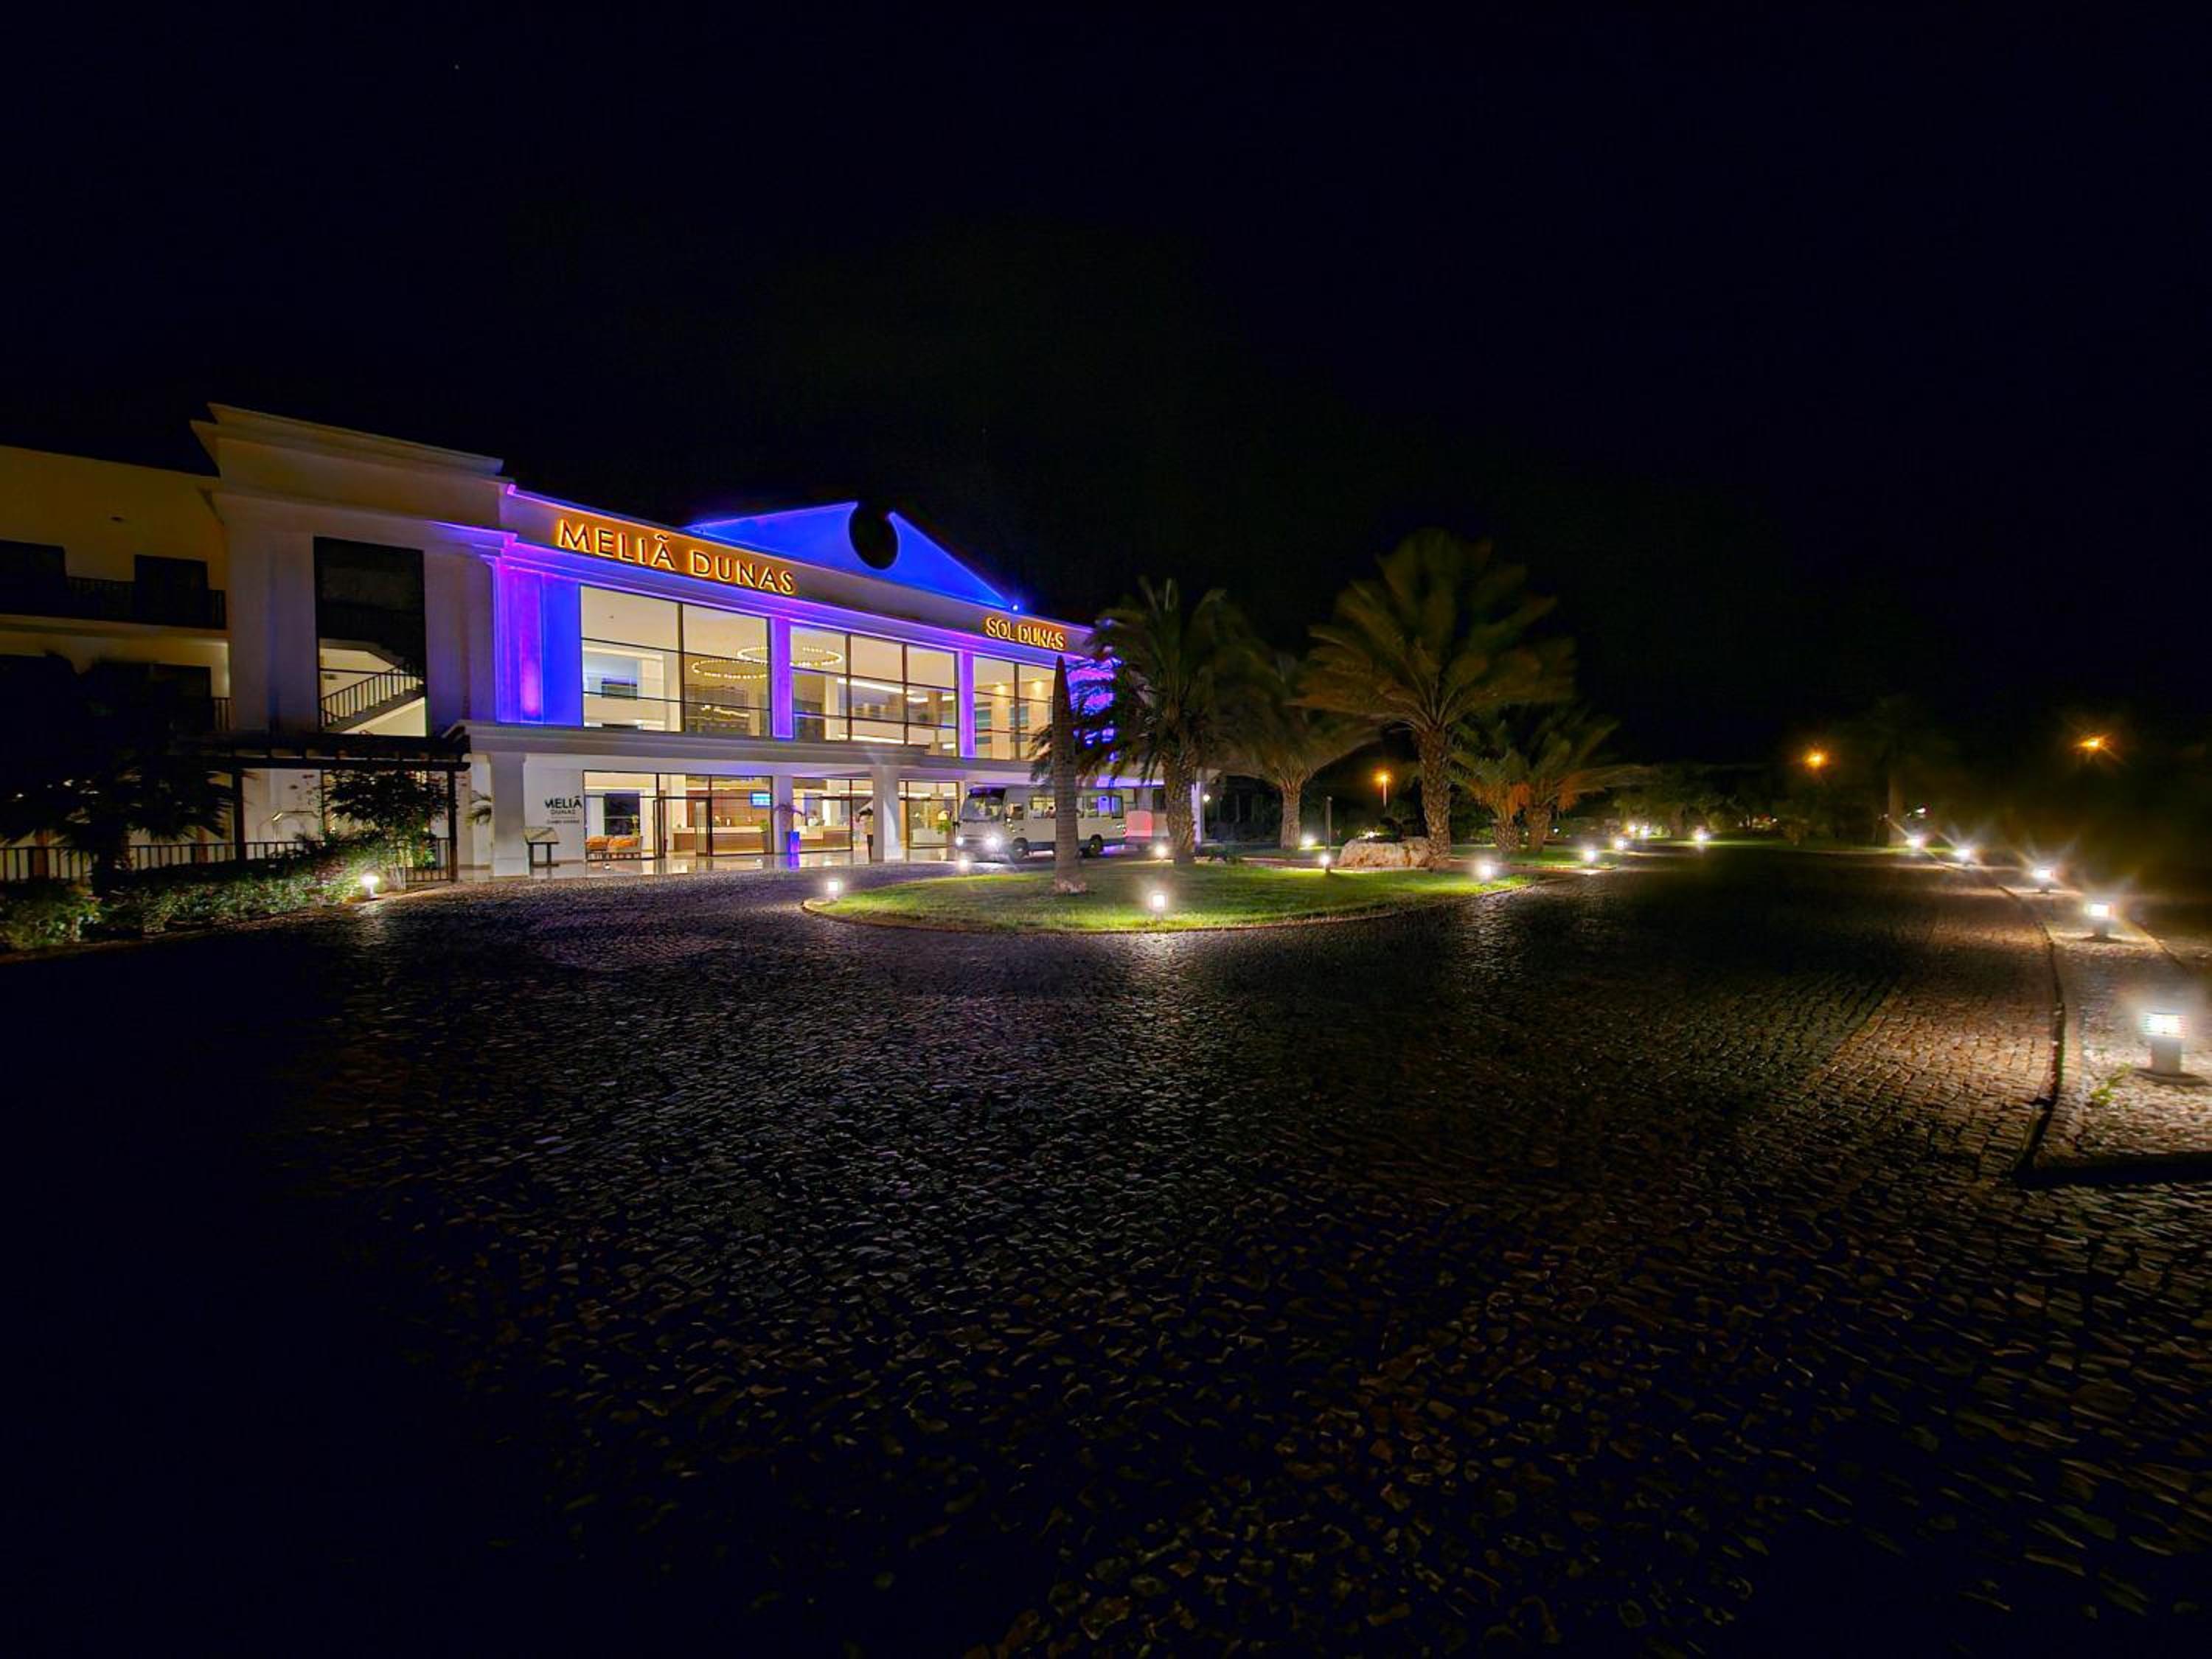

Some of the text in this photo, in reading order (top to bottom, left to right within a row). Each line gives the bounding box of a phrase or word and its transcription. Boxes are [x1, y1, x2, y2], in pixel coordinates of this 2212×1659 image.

[691, 549, 795, 595] DUNAS
[985, 616, 1066, 651] SOL DUNAS
